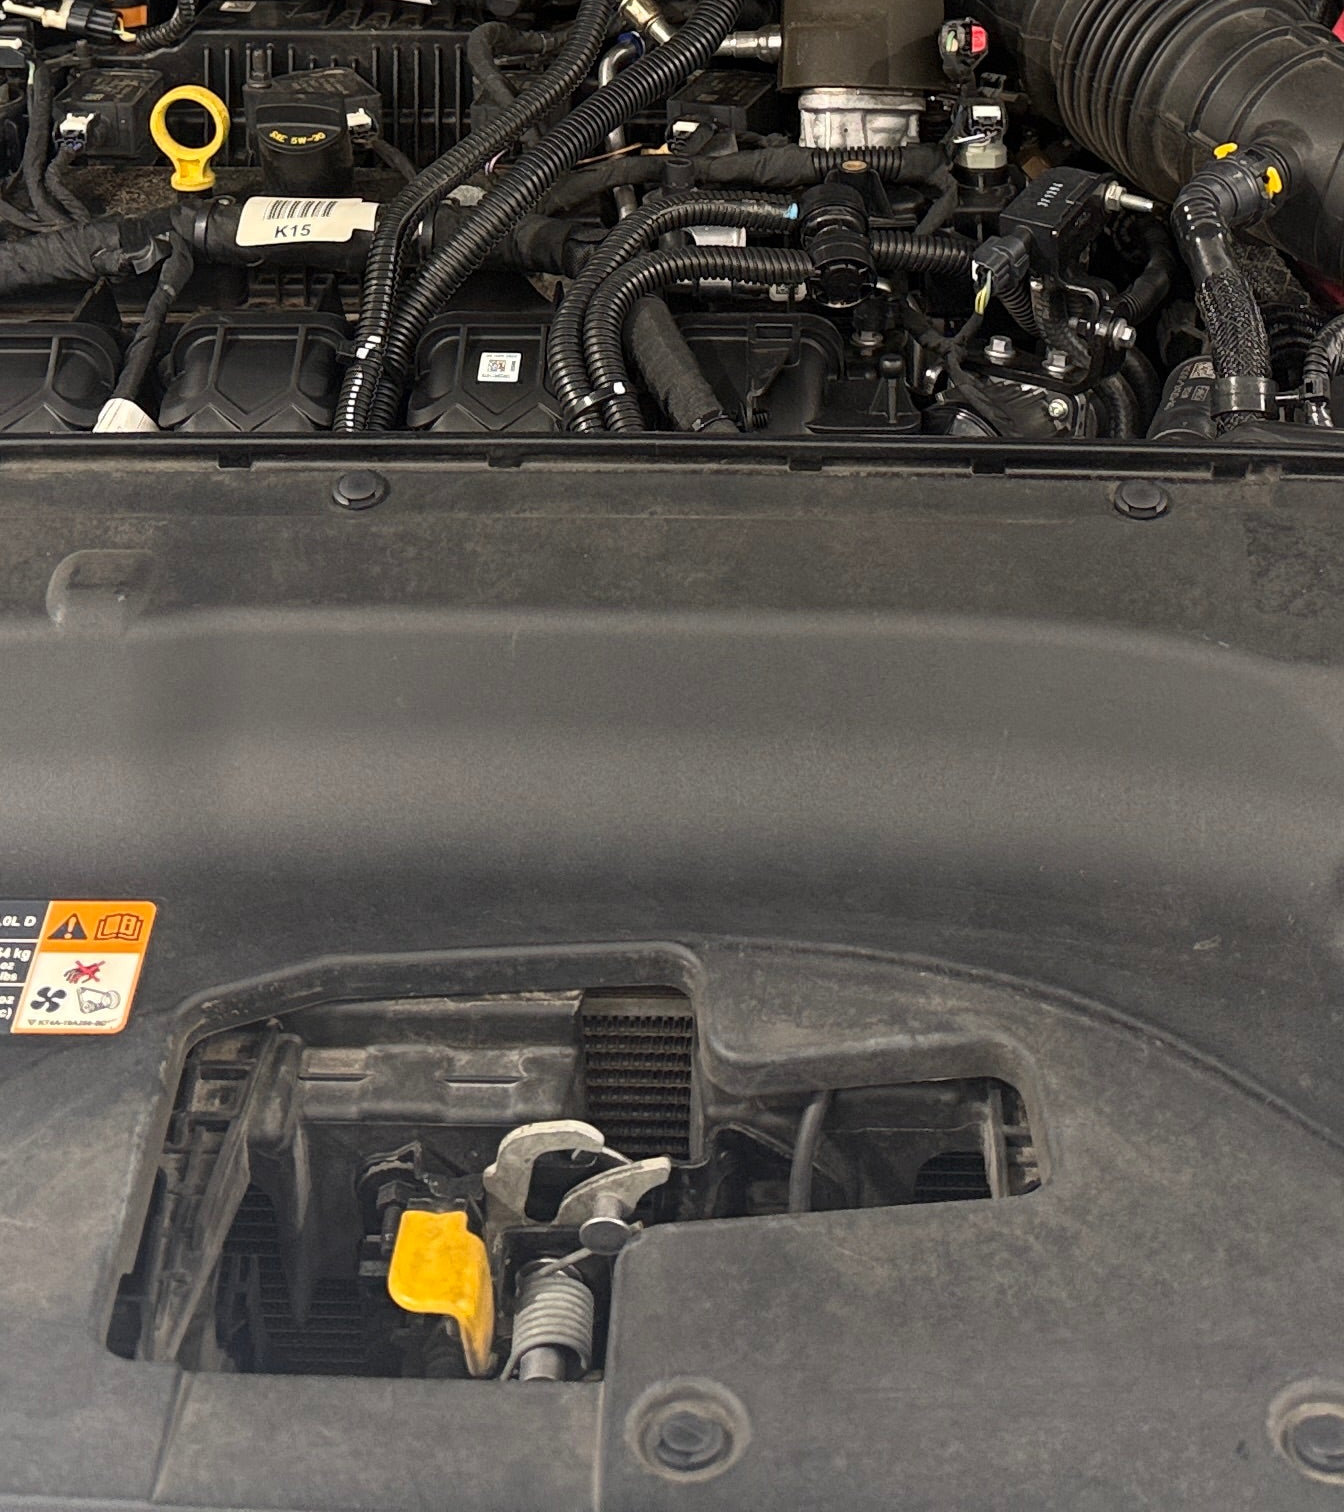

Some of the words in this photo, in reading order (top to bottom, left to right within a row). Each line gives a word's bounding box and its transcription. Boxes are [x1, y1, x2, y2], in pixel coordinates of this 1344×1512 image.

[274, 223, 312, 238] K15
[23, 915, 37, 928] D
[13, 947, 32, 962] kg
[0, 961, 16, 970] oz
[0, 971, 18, 982] lbs
